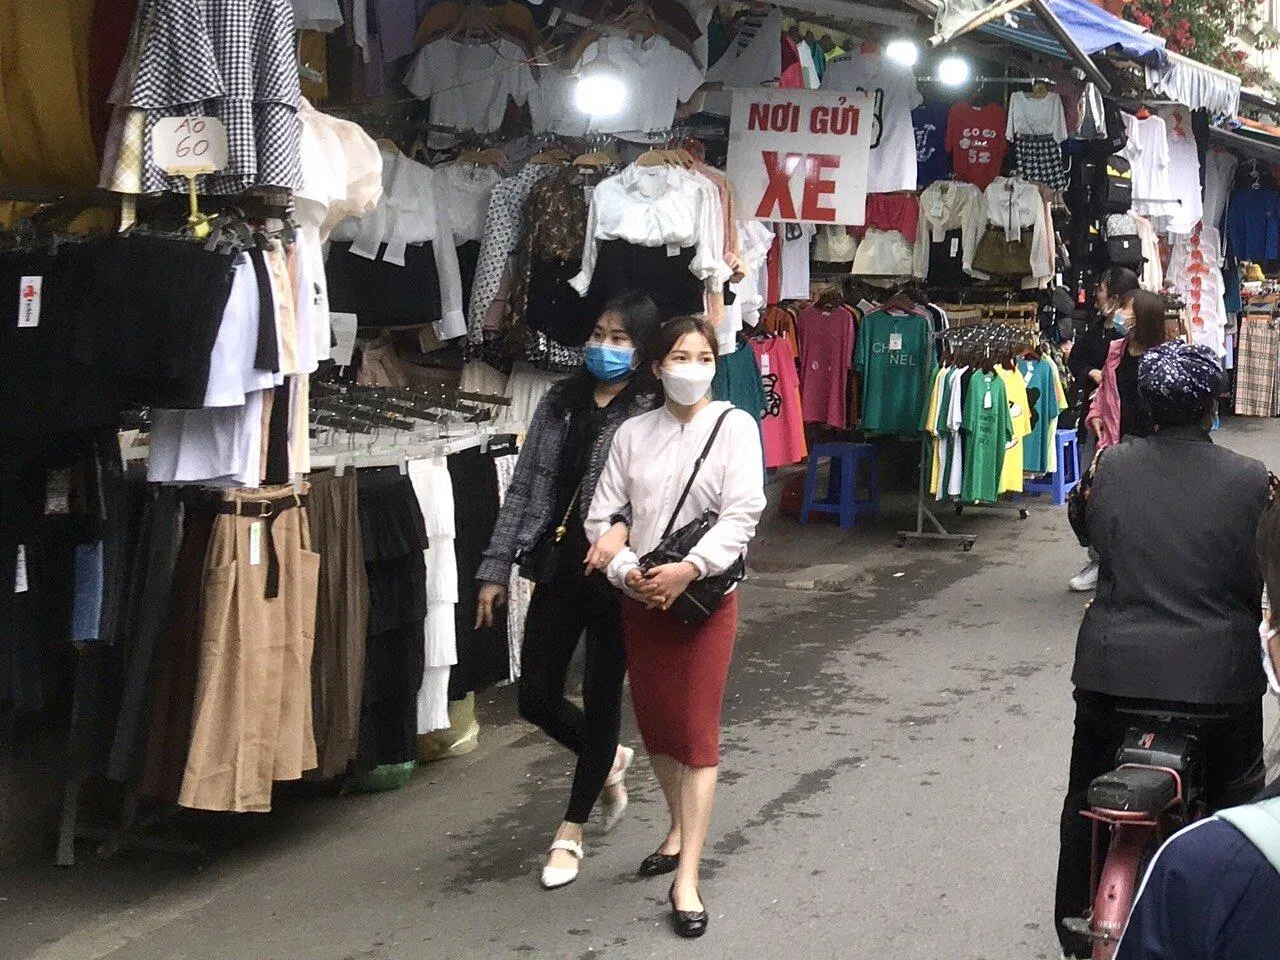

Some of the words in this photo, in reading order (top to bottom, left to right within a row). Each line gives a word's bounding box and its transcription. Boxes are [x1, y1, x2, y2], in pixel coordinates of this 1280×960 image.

[748, 101, 801, 133] NƠI
[809, 96, 861, 136] GỬI
[175, 135, 210, 158] 60
[754, 150, 842, 222] XE
